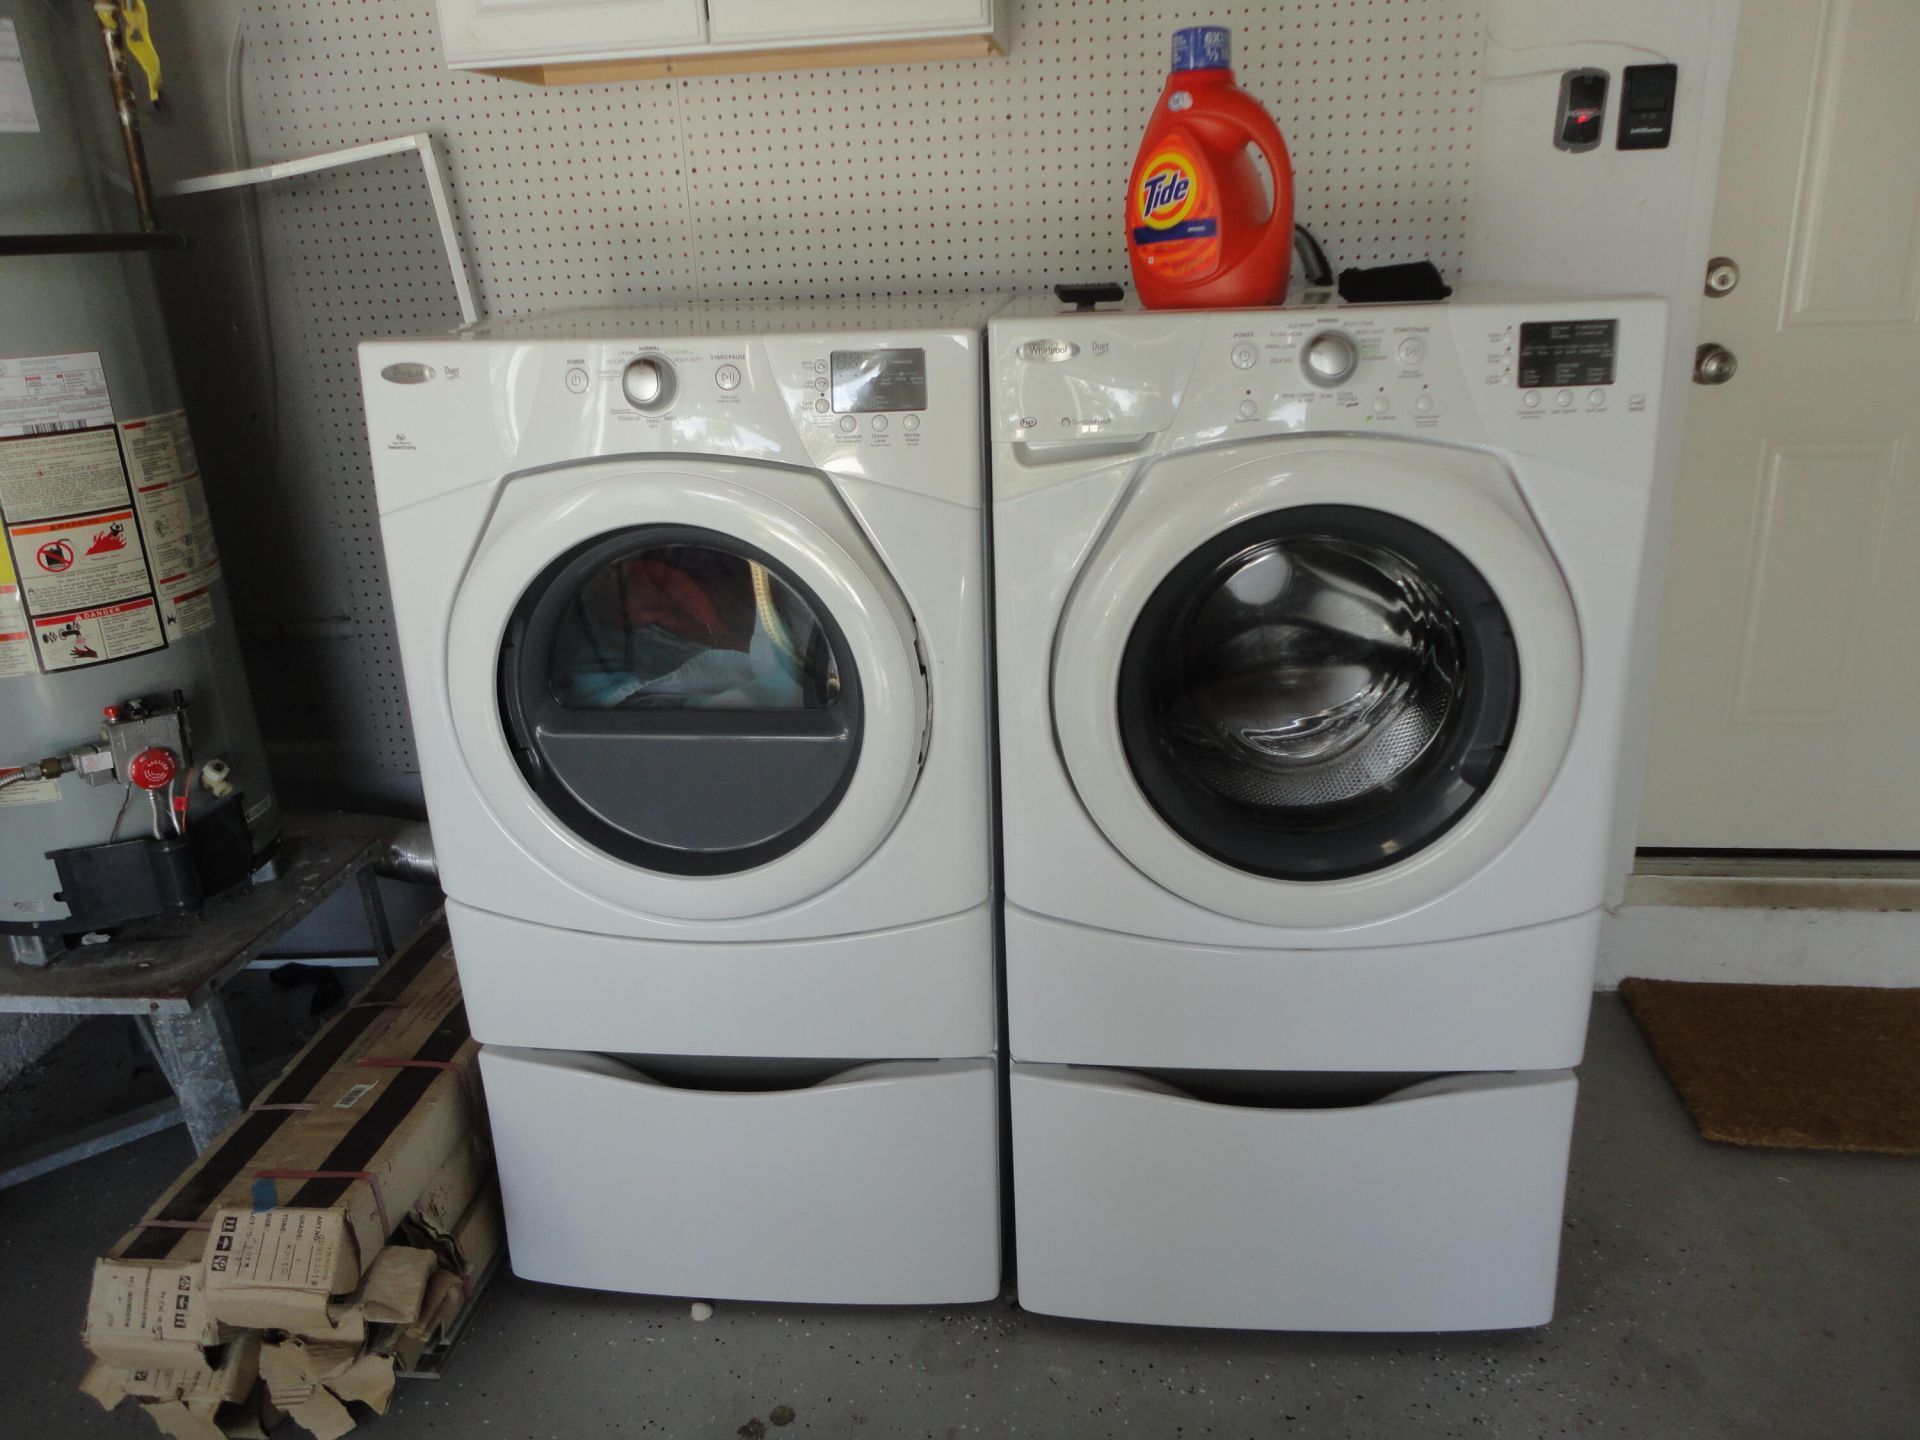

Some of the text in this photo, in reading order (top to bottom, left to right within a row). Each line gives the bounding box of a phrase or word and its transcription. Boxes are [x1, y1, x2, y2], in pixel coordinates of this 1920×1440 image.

[1204, 32, 1221, 47] 6X
[1143, 170, 1190, 219] Tide
[1029, 345, 1068, 356] Whirlpool
[1091, 341, 1110, 351] Duet
[84, 607, 121, 619] DANGER
